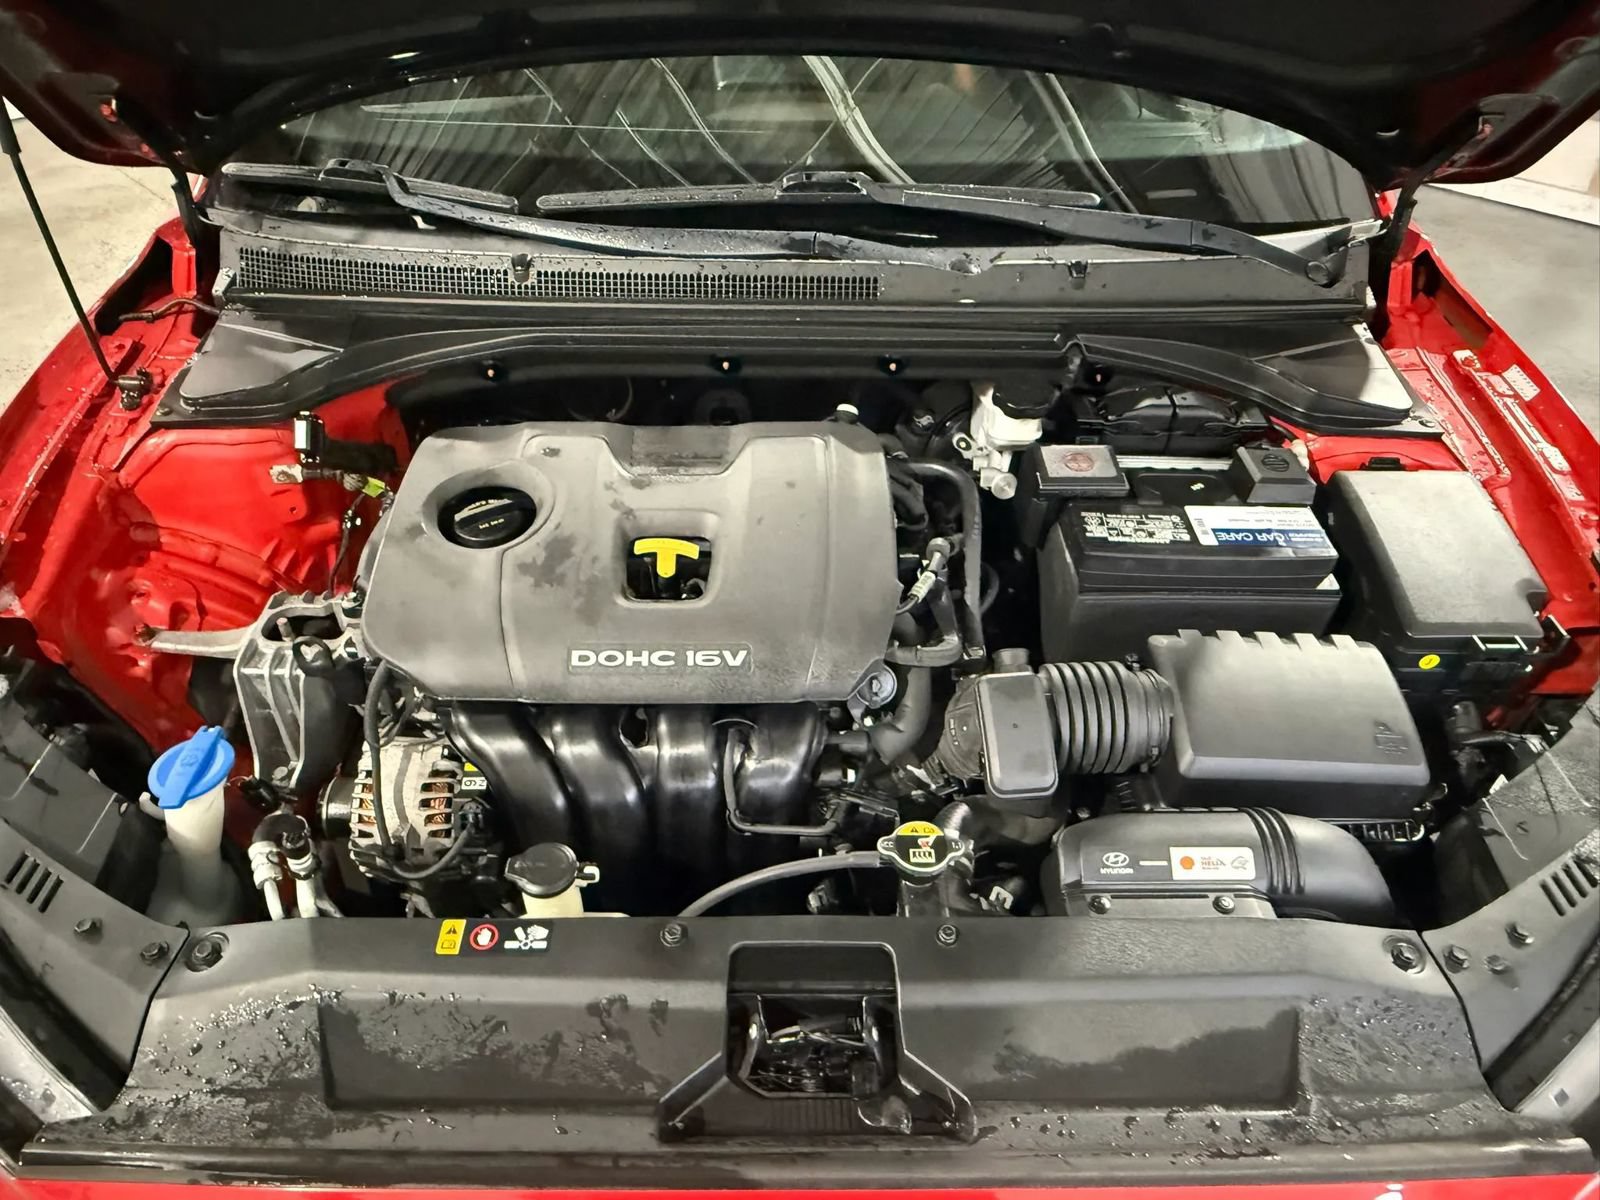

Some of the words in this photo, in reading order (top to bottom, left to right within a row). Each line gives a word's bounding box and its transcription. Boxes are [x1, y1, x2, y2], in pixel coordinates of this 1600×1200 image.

[1217, 532, 1254, 541] CARE
[1256, 532, 1285, 542] CAR
[571, 650, 676, 667] DOHC
[685, 650, 748, 667] 16V
[1100, 867, 1134, 875] HYUNDAI
